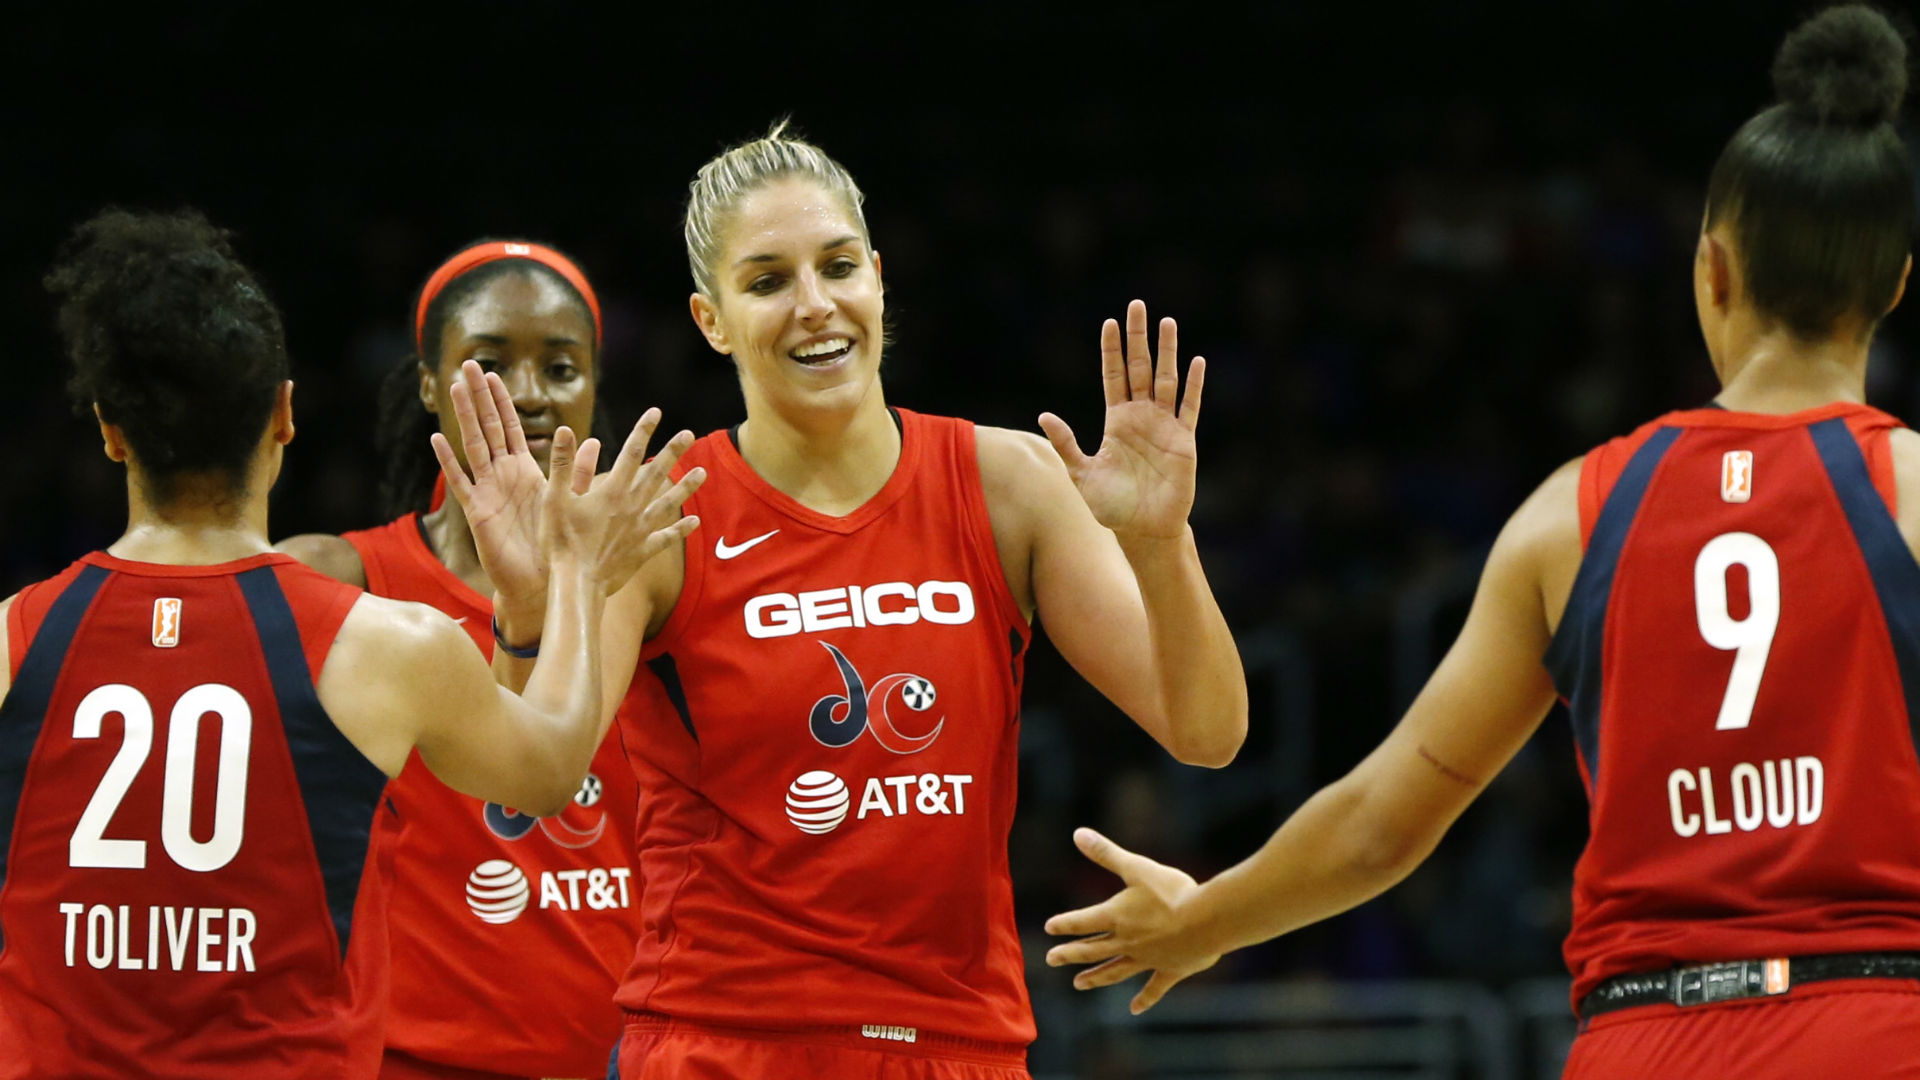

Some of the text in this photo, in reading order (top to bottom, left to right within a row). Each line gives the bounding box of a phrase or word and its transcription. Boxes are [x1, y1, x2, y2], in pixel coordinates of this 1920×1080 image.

[744, 579, 976, 639] GEICO
[1694, 531, 1781, 731] 9
[68, 683, 253, 873] 20
[857, 773, 973, 820] AT&T
[1667, 756, 1825, 838] CLOUD
[539, 867, 632, 912] AT&T
[59, 902, 257, 973] TOLIVER
